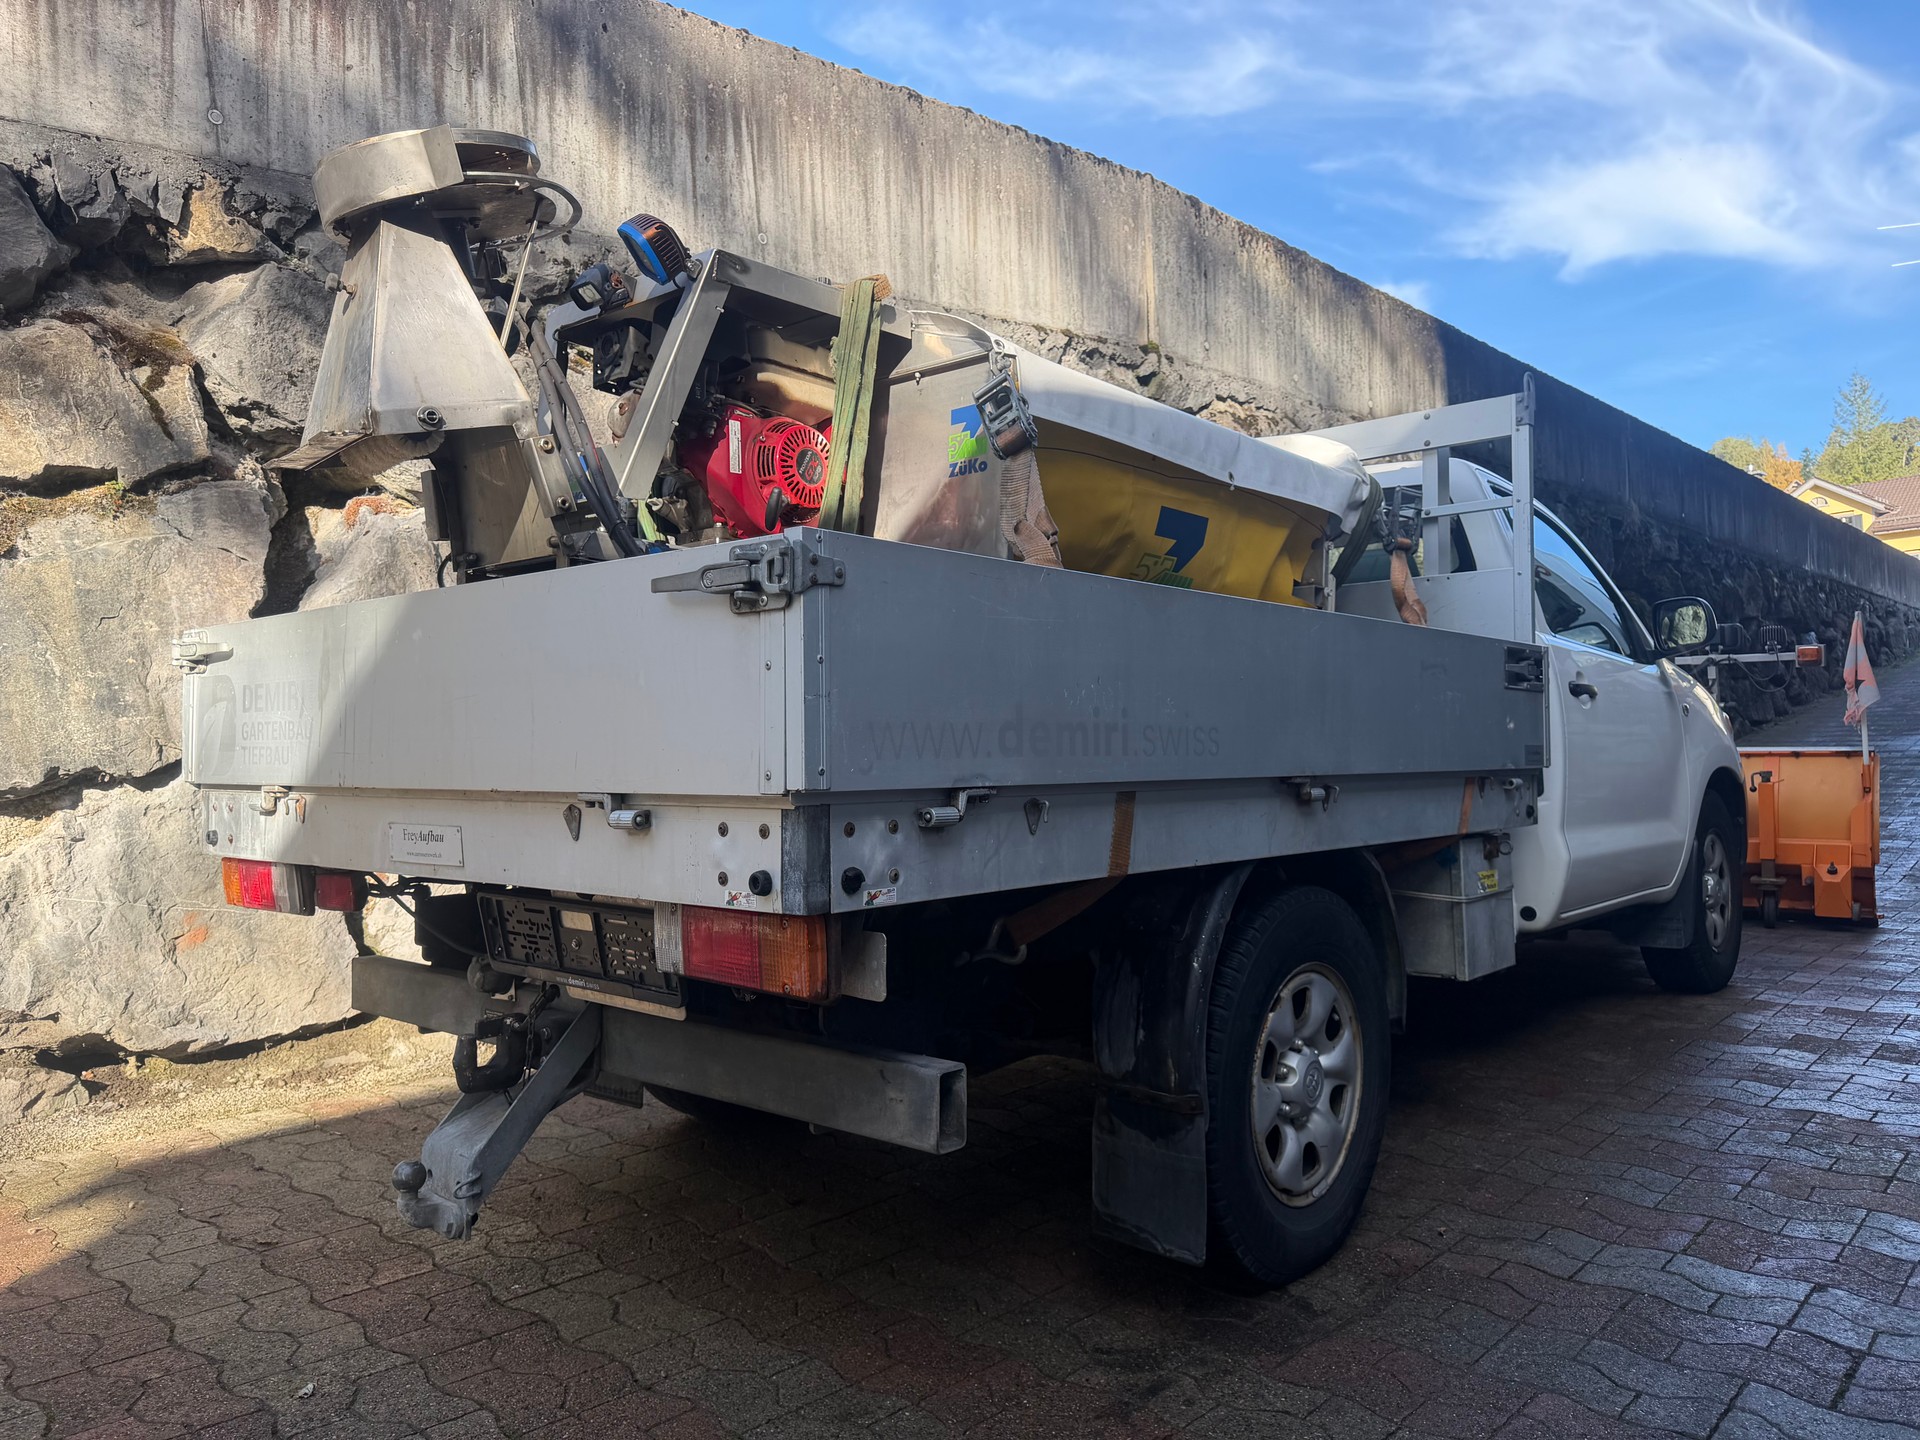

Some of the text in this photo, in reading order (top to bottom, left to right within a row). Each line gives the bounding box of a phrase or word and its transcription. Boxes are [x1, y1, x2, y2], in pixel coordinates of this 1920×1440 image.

[799, 451, 812, 474] HONDA
[948, 458, 988, 478] ZüKo
[241, 720, 313, 741] GARTENBAU
[868, 704, 1221, 760] www.demiri.swiss
[241, 746, 290, 766] TIEFBAU
[556, 976, 600, 990] www.demiri.swiss
